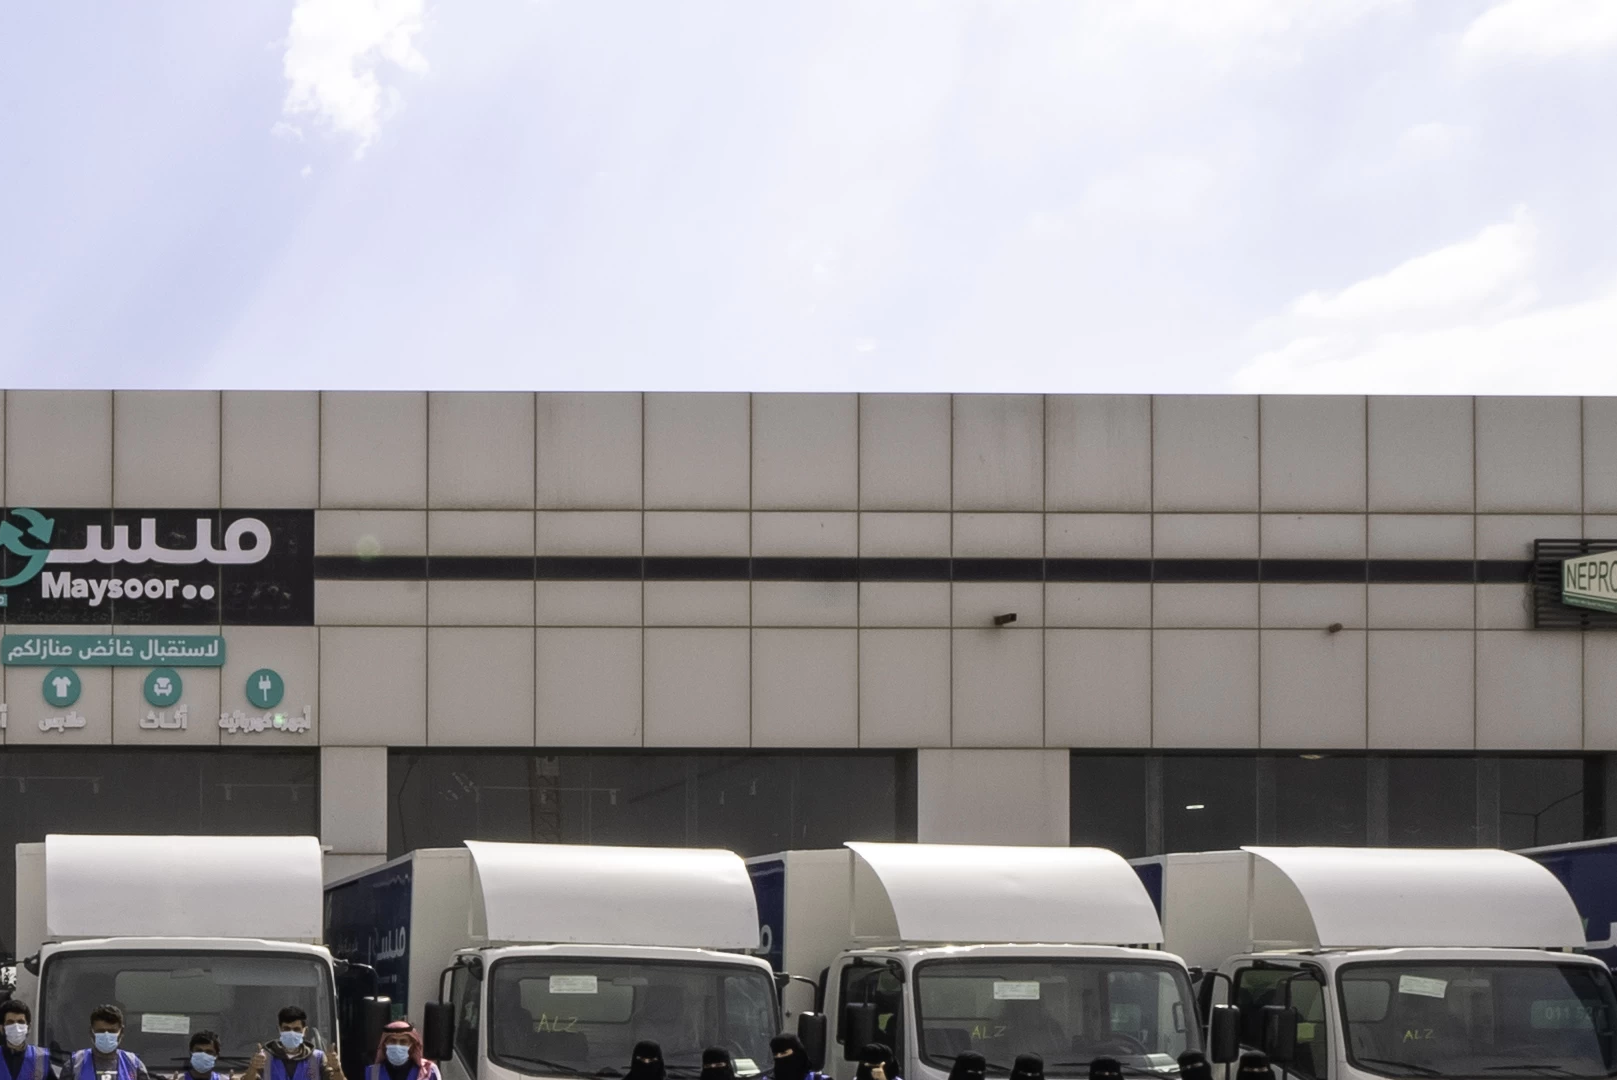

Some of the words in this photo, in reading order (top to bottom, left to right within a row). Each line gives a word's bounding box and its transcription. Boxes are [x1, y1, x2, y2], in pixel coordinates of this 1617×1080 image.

[8, 638, 73, 661] منازلكم
[78, 638, 133, 661] فائض
[140, 638, 219, 661] لاستقبال
